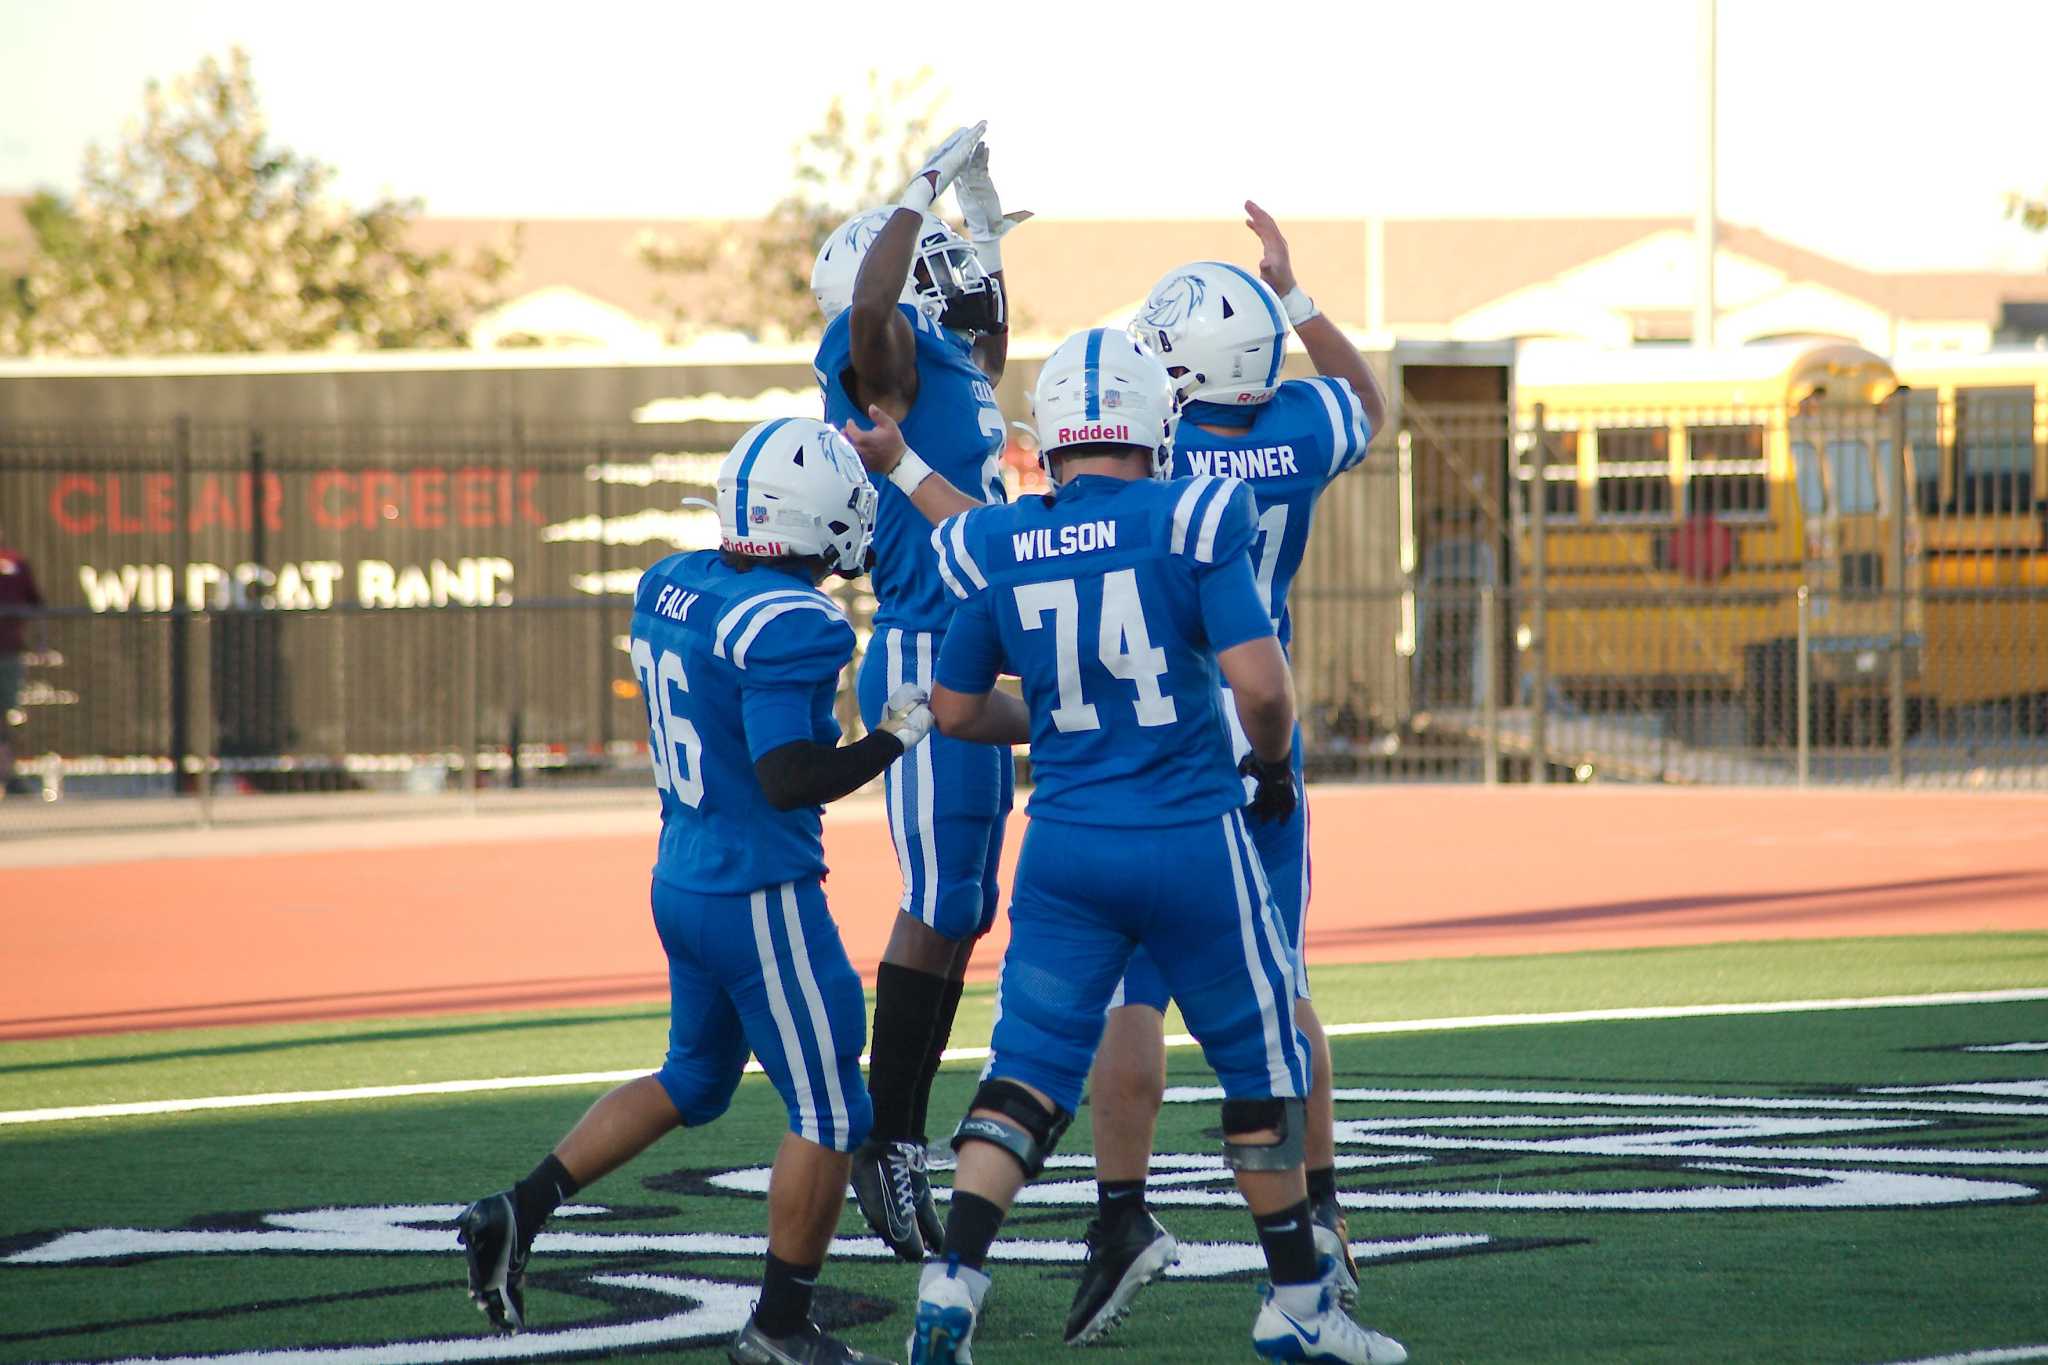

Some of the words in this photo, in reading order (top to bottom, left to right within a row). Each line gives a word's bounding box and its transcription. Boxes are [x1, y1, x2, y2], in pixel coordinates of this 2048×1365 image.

[1058, 425, 1129, 443] Riddell
[1187, 445, 1299, 478] WENNER
[49, 473, 284, 535] CLEAR
[307, 467, 547, 531] CREEK
[722, 537, 783, 556] Riddell
[1013, 520, 1117, 561] WILSON
[655, 584, 699, 622] FALK
[1013, 568, 1178, 733] 74
[631, 638, 705, 808] 36
